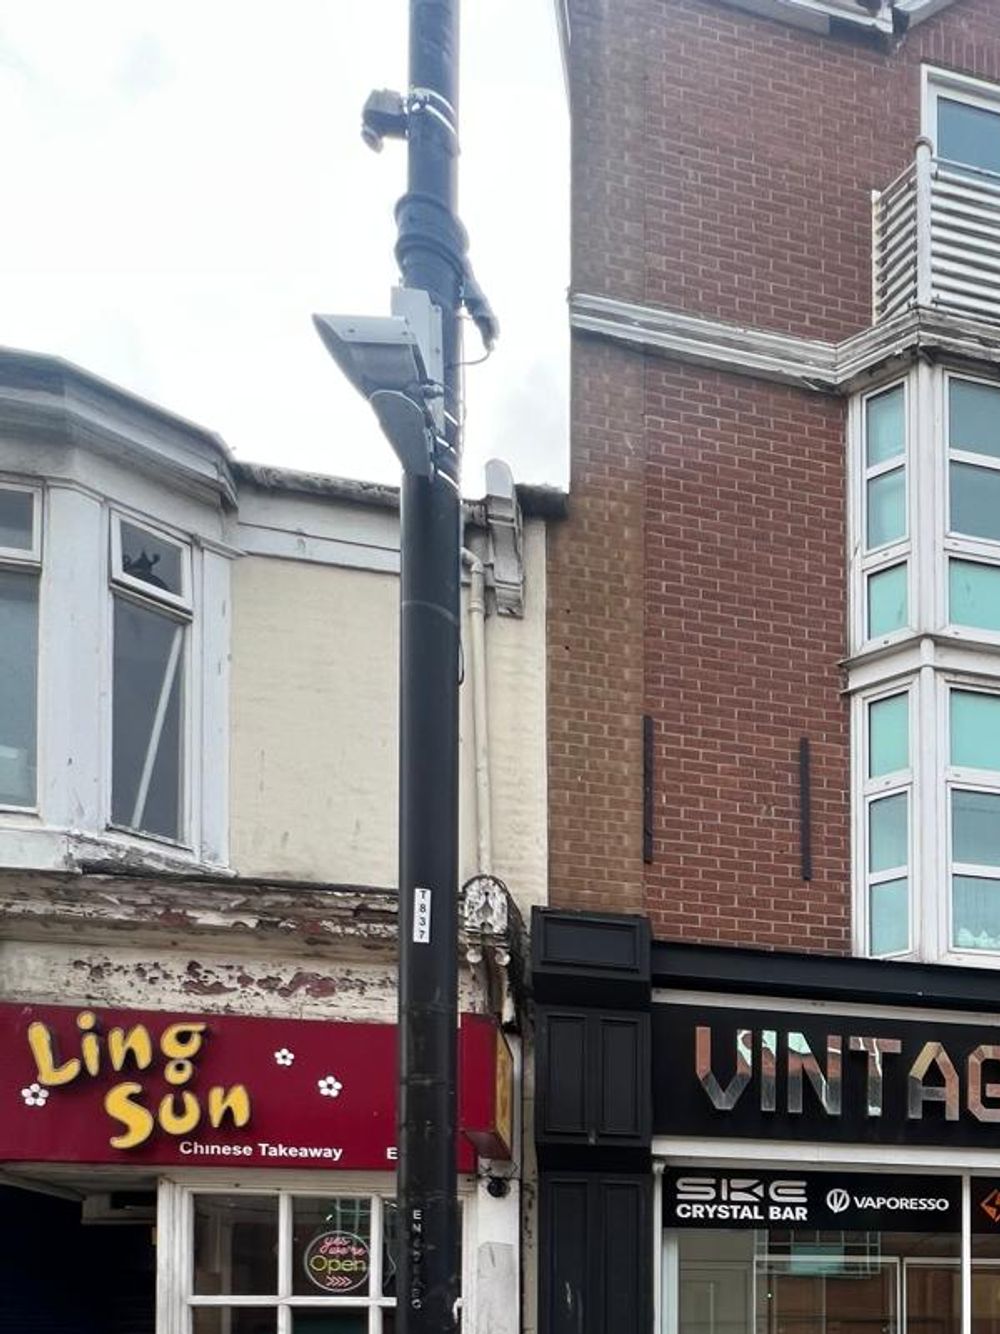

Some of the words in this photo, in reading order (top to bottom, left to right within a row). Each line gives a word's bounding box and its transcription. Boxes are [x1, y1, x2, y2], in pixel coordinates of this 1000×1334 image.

[419, 889, 428, 940] T837
[28, 1010, 207, 1086] Ling
[105, 1081, 250, 1149] Sun
[179, 1141, 253, 1157] Chinese
[258, 1143, 343, 1161] Takeaway
[676, 1177, 808, 1204] SKE
[676, 1203, 764, 1220] CRYSTAL
[768, 1206, 808, 1221] BAR
[853, 1196, 950, 1211] VAPORESSO
[310, 1255, 367, 1275] Open
